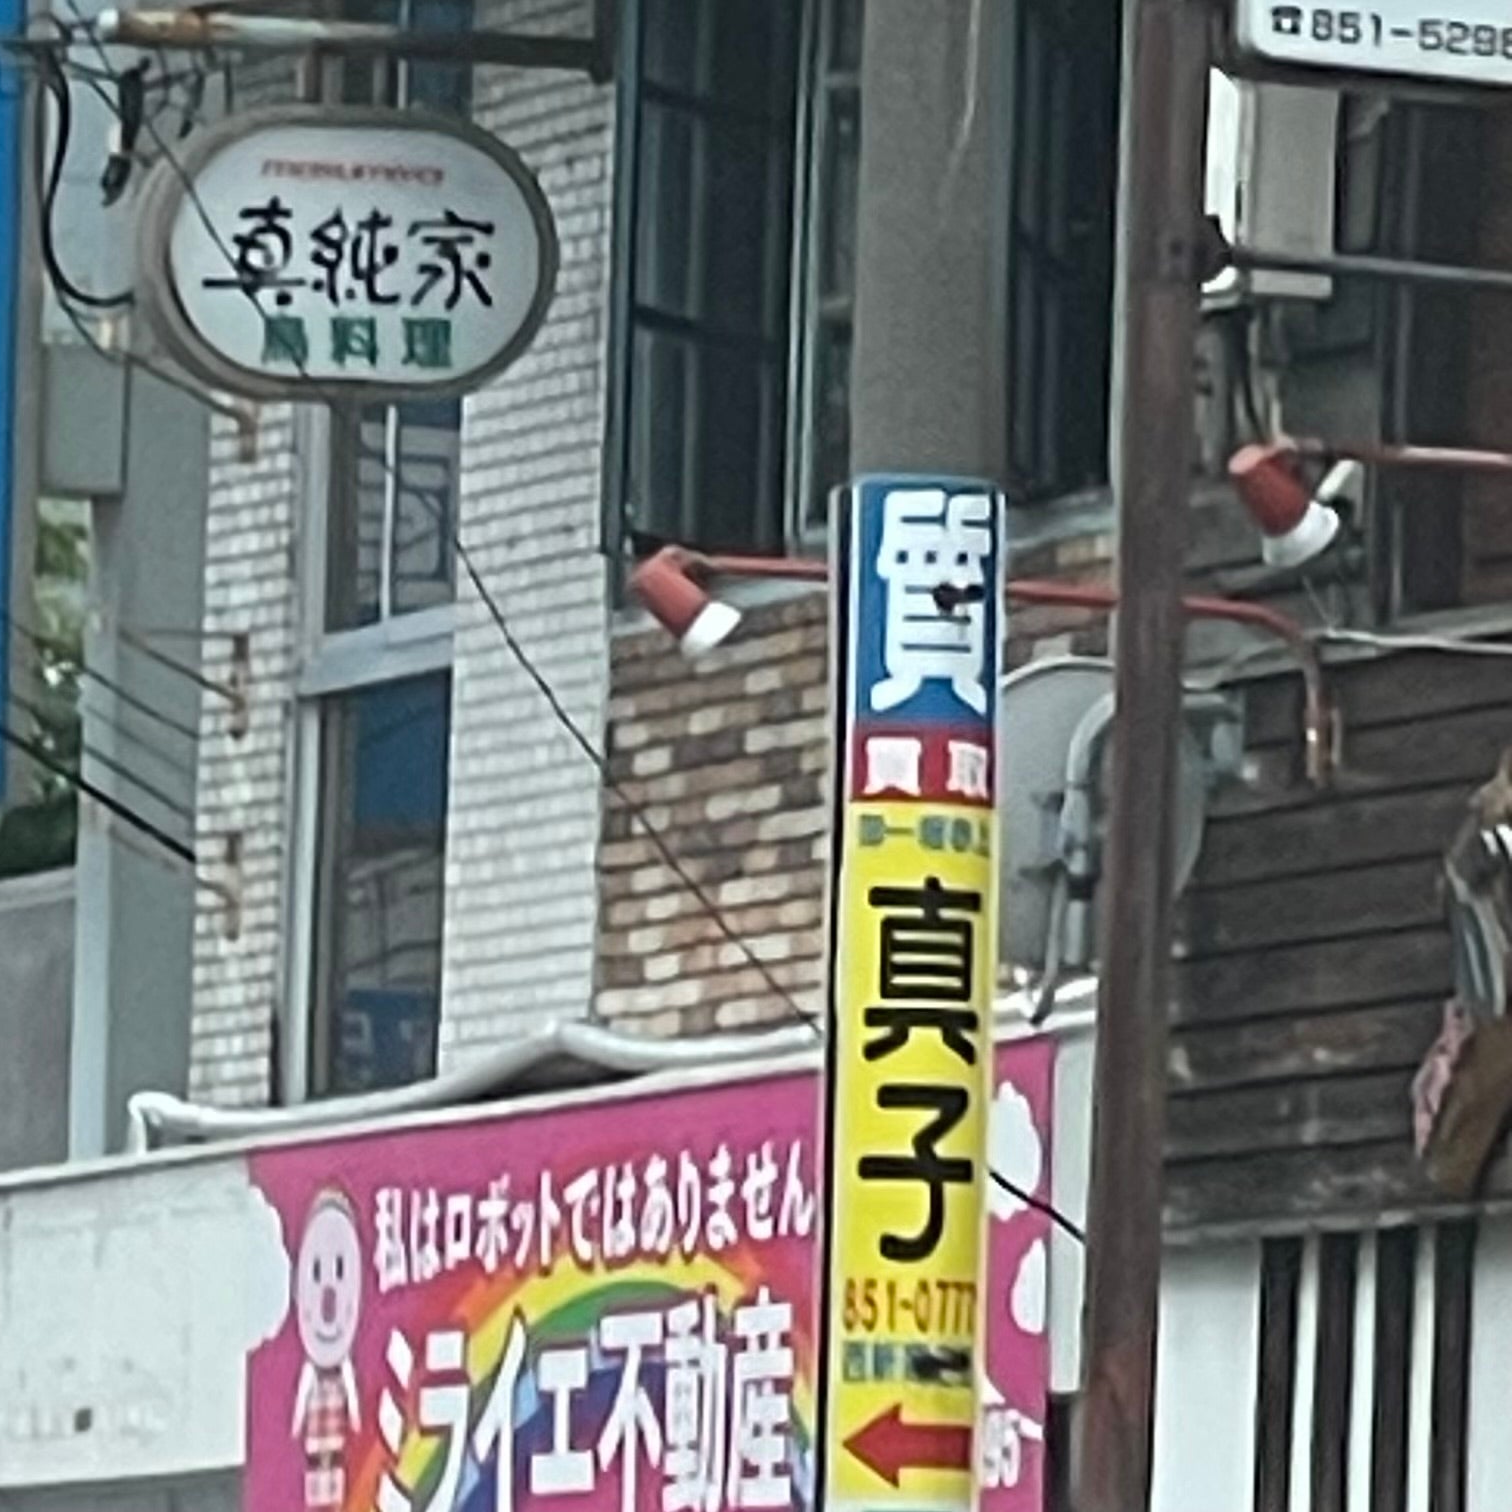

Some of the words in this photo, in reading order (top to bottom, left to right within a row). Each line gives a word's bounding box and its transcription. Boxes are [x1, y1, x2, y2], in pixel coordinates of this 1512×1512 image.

[871, 490, 990, 715] 質
[858, 876, 981, 1262] 真子
[373, 1139, 814, 1292] 私はロボットではありません
[376, 1285, 795, 1512] ミライエ不動産
